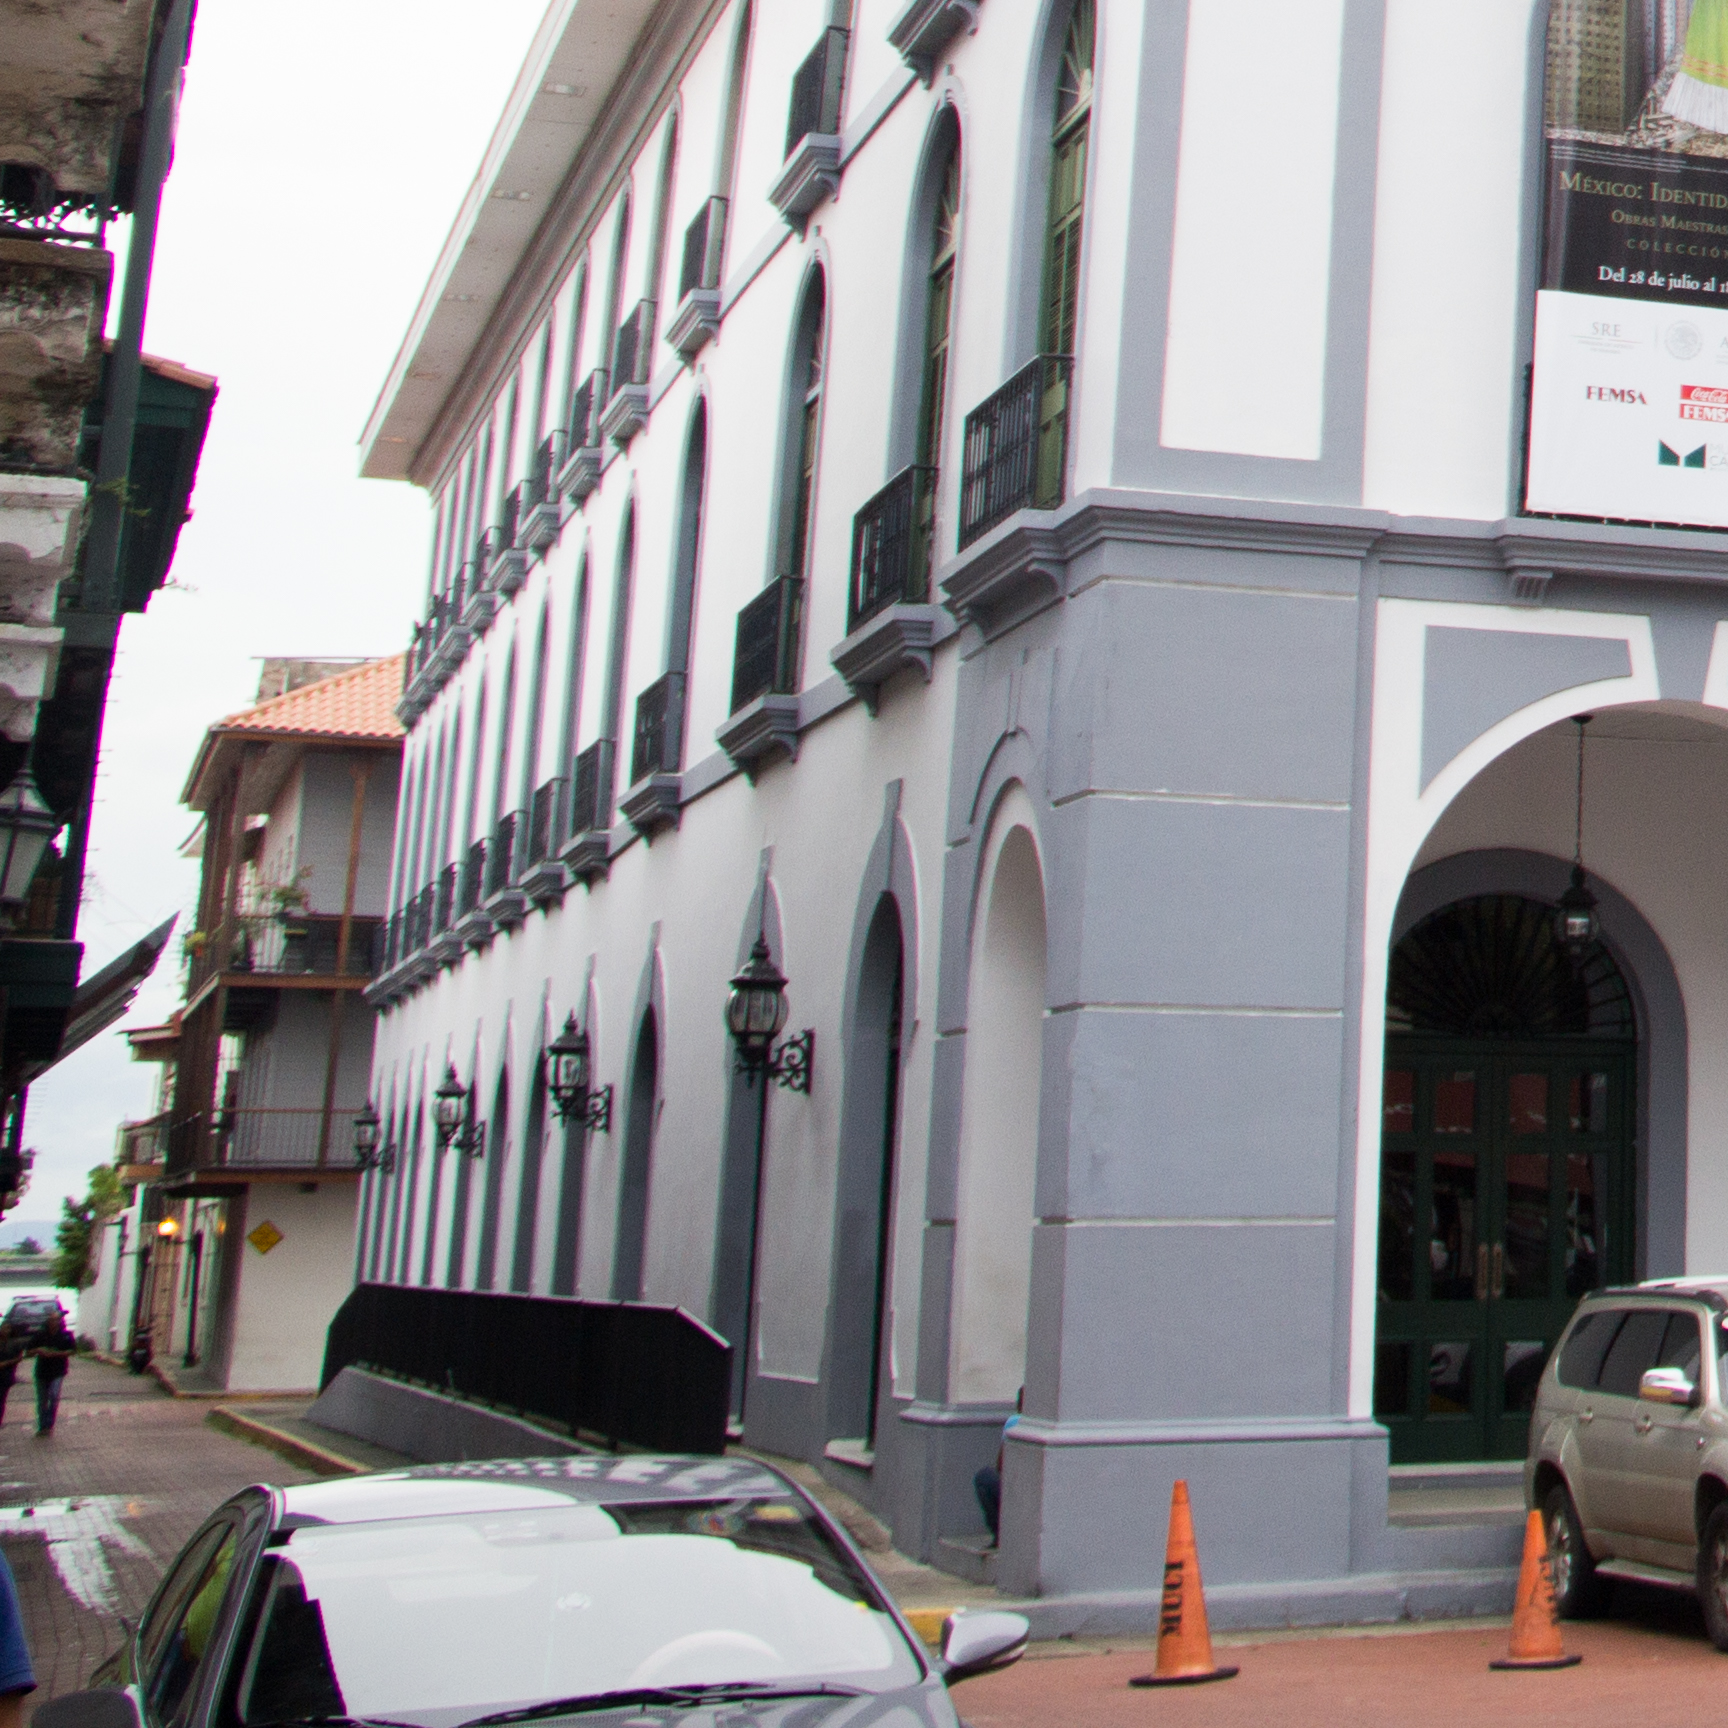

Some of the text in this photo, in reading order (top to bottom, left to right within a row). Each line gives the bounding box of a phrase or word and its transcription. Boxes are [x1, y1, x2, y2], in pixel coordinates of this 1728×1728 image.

[1611, 209, 1656, 227] OBRAS
[1598, 265, 1626, 282] Del
[1628, 270, 1645, 284] 28
[1648, 270, 1665, 286] de
[1668, 272, 1700, 291] julio
[1702, 276, 1716, 292] al
[1591, 321, 1621, 338] SRE
[1586, 385, 1647, 405] FEMSA
[1162, 1560, 1184, 1638] MUCI
